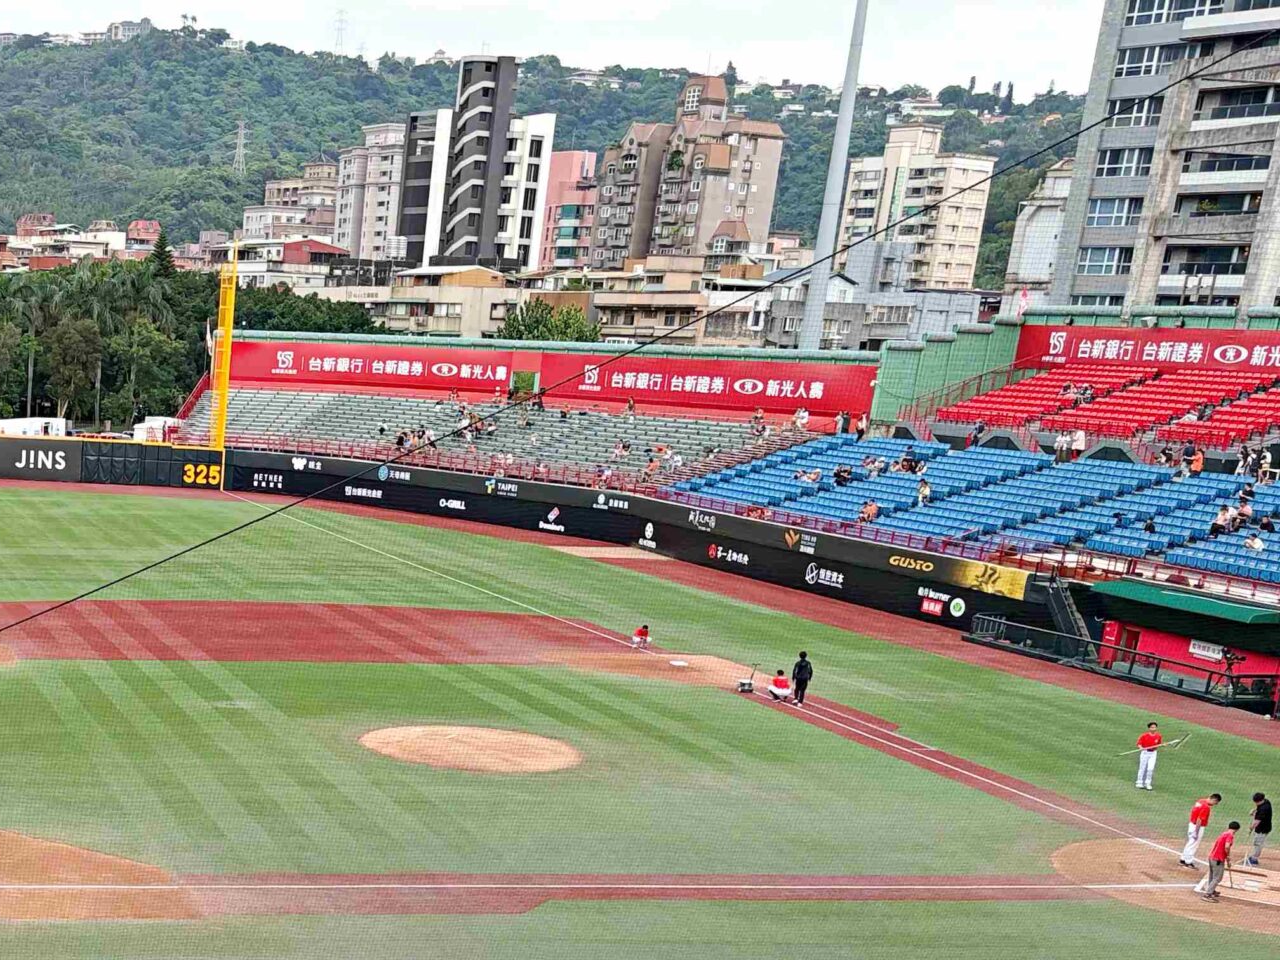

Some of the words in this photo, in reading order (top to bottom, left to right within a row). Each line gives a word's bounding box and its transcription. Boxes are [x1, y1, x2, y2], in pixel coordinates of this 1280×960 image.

[1077, 339, 1134, 361] 台新銀行
[1142, 342, 1203, 364] 台新證券
[308, 358, 364, 373] 台新銀行
[372, 360, 424, 377] 台新證券
[460, 364, 507, 381] 新光人壽
[611, 372, 663, 391] 台新銀行
[671, 375, 725, 394] 台新證券
[766, 380, 824, 399] 新光人壽
[183, 463, 221, 485] 325
[888, 554, 935, 573] GUSTO
